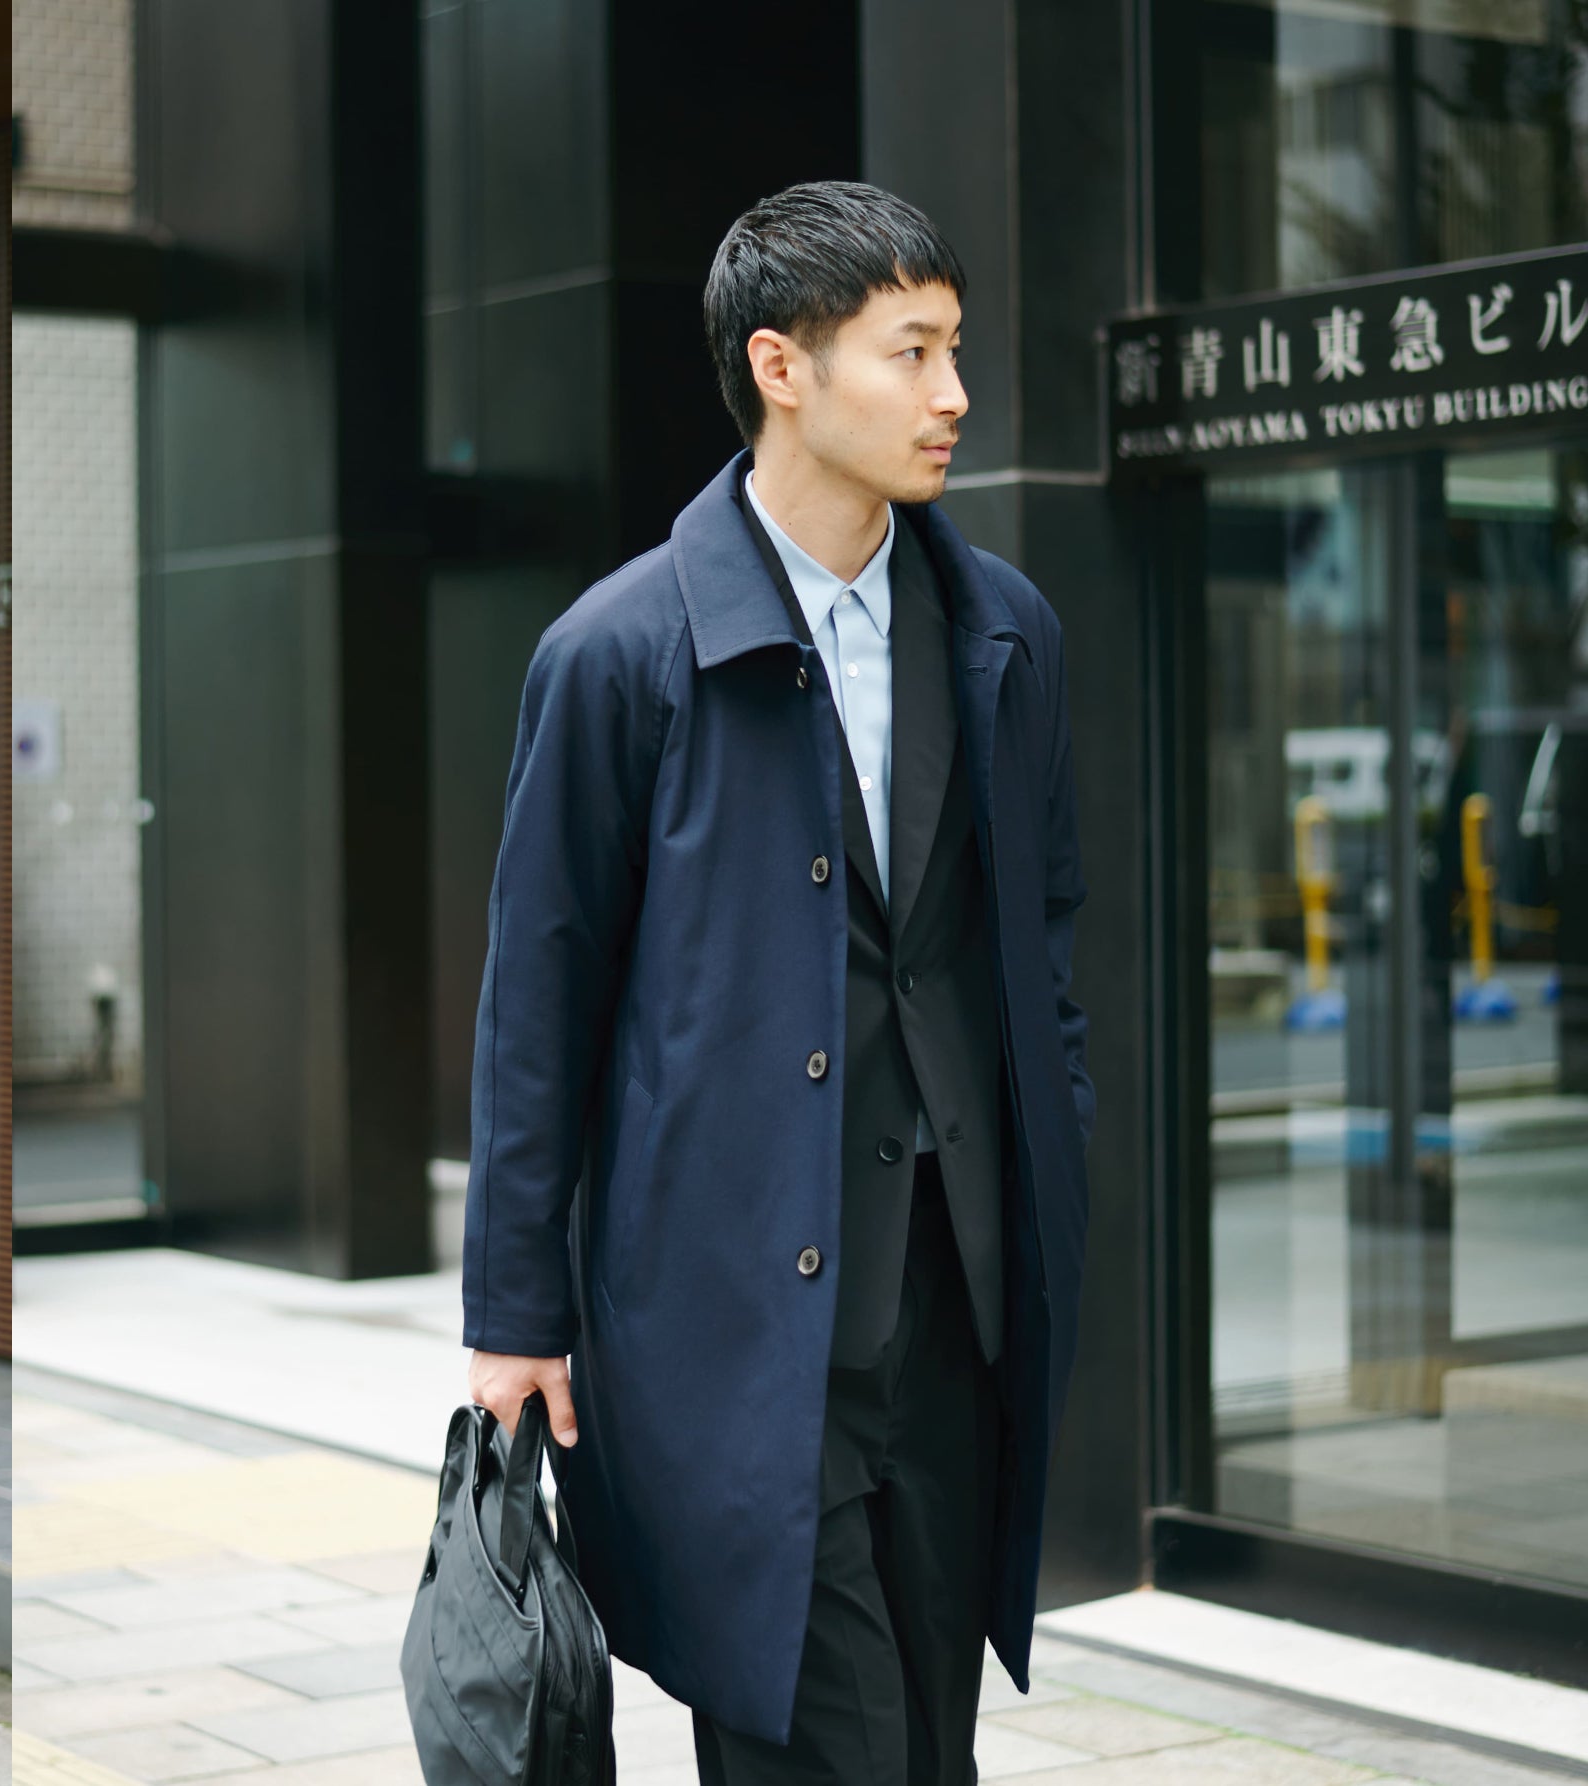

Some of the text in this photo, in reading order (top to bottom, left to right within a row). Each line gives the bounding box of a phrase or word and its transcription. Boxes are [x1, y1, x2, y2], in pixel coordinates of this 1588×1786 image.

[1115, 279, 1588, 406] 新青山東急ビル
[1319, 395, 1424, 437] TOKYU
[1433, 375, 1588, 426] BUILDING
